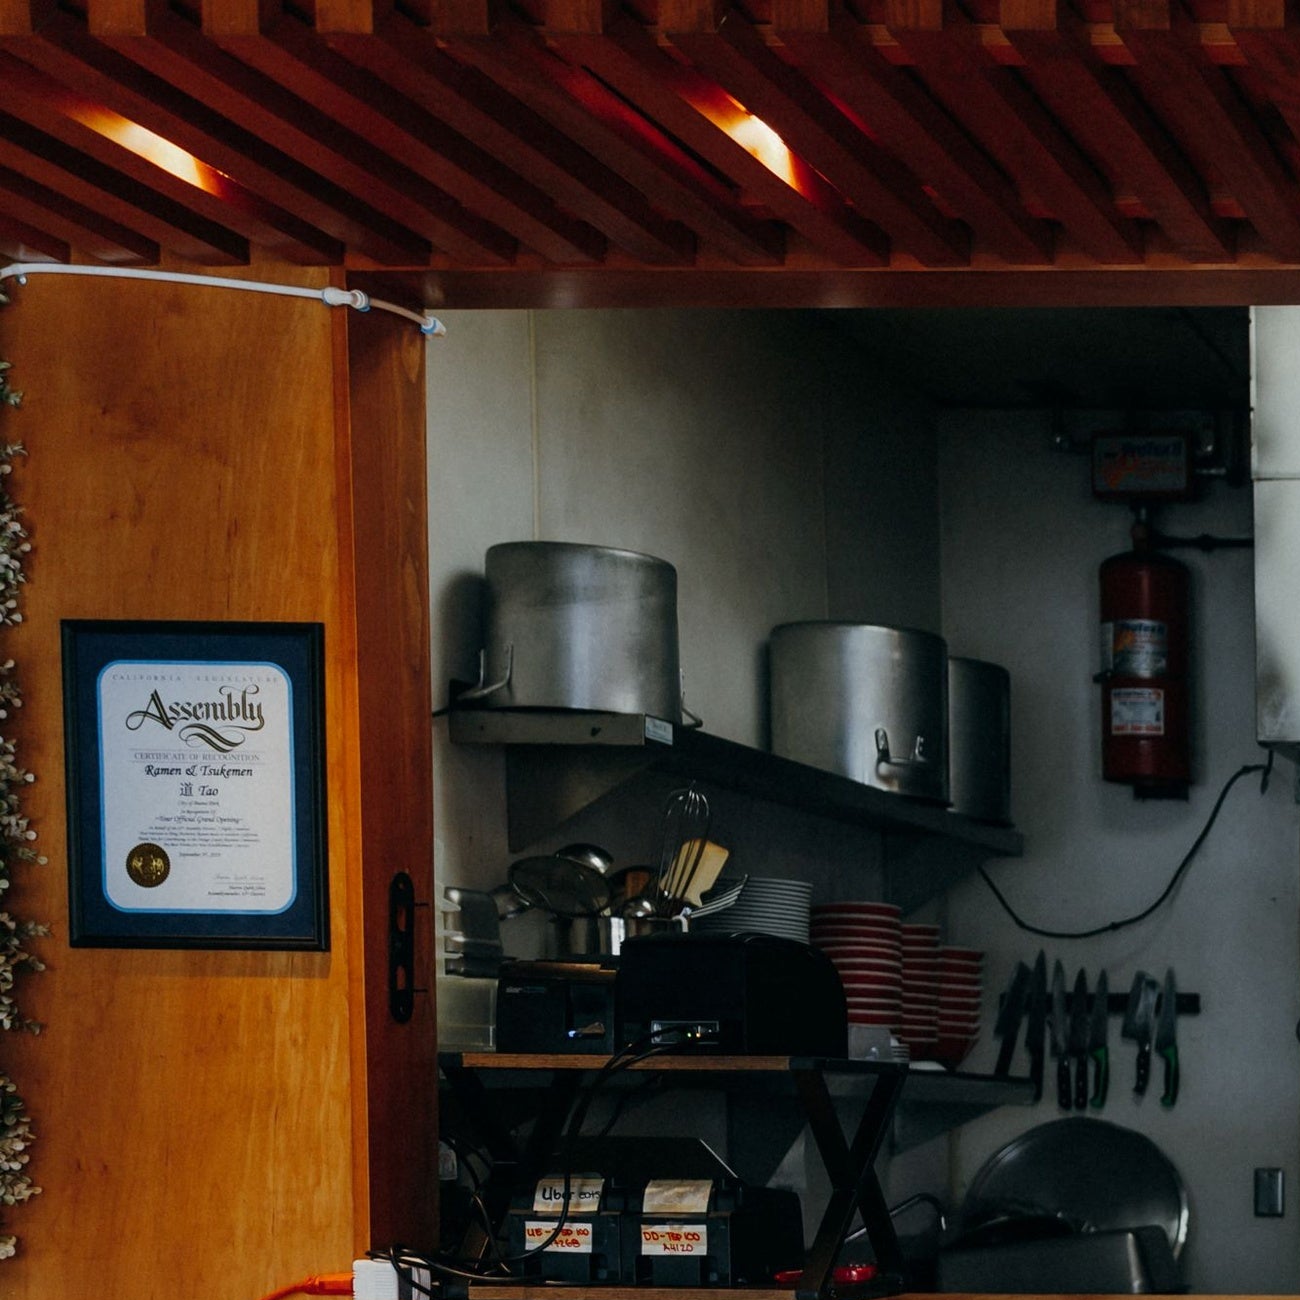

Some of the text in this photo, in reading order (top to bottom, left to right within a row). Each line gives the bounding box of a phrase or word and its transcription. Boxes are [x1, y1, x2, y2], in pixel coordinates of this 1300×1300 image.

[126, 684, 264, 731] Assembly
[202, 753, 260, 761] RECOGNITION
[145, 765, 253, 778] Ramen & Tsukemen
[180, 782, 218, 797] 道 Tao
[542, 1187, 574, 1201] Ubr
